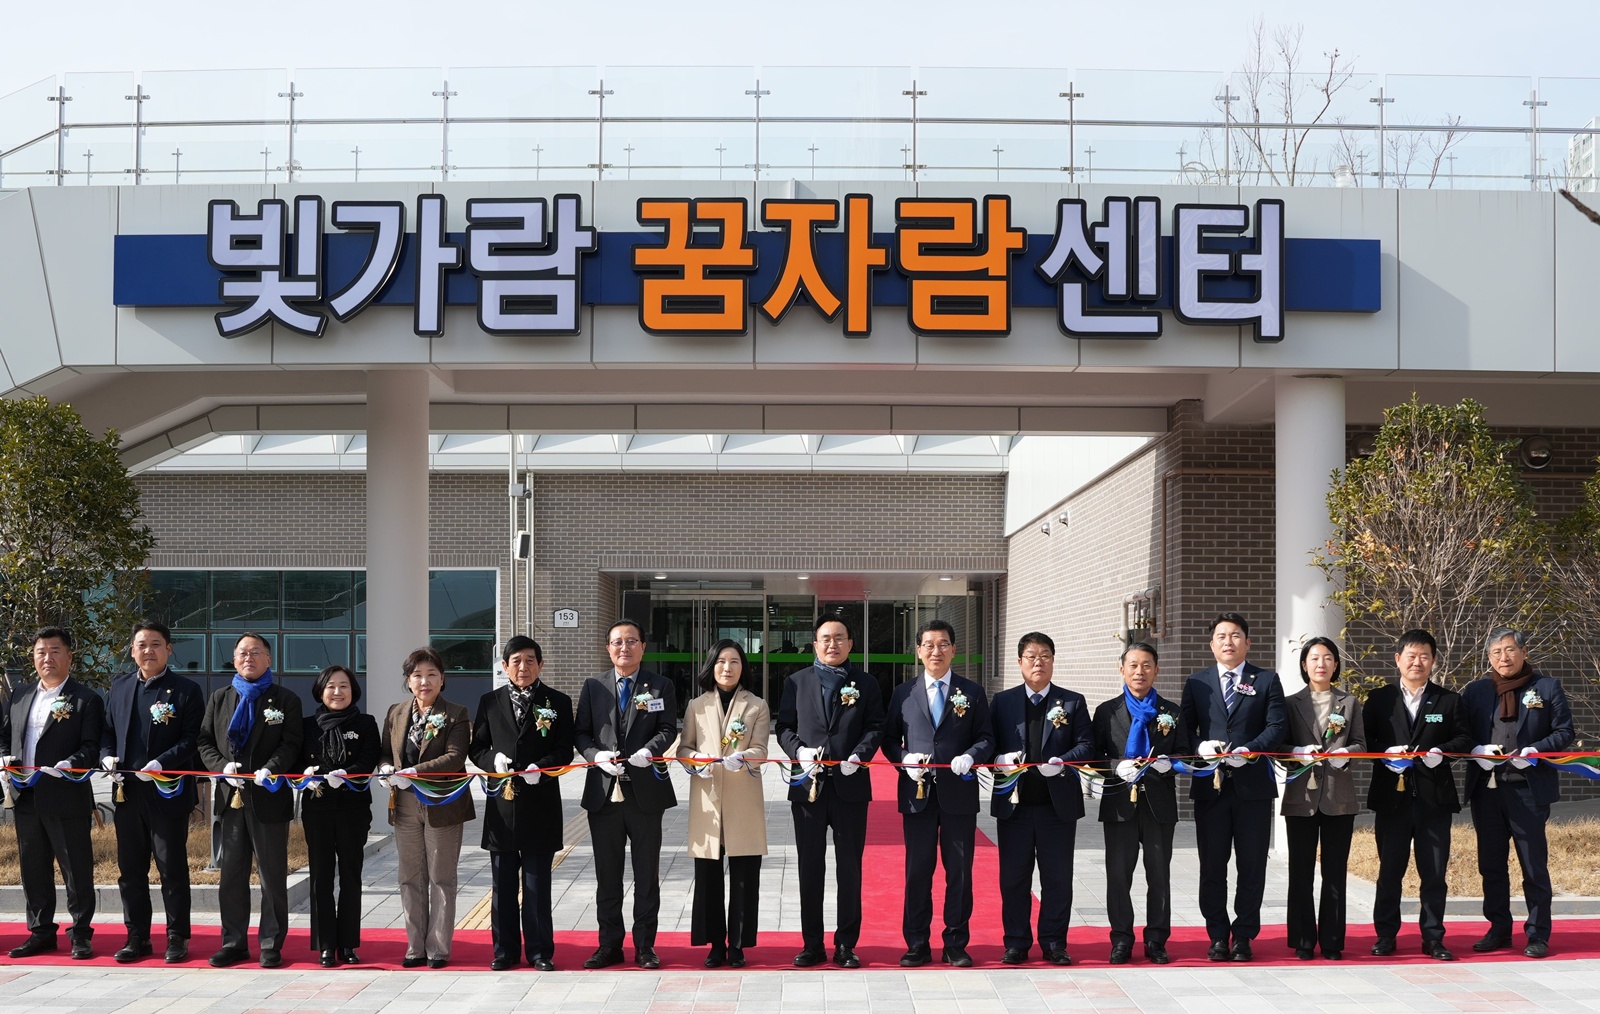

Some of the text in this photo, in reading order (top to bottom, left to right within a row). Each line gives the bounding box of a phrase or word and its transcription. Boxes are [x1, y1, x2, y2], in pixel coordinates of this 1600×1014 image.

[208, 193, 1286, 343] 빛가람 꿈자람 센터
[559, 612, 574, 621] 153
